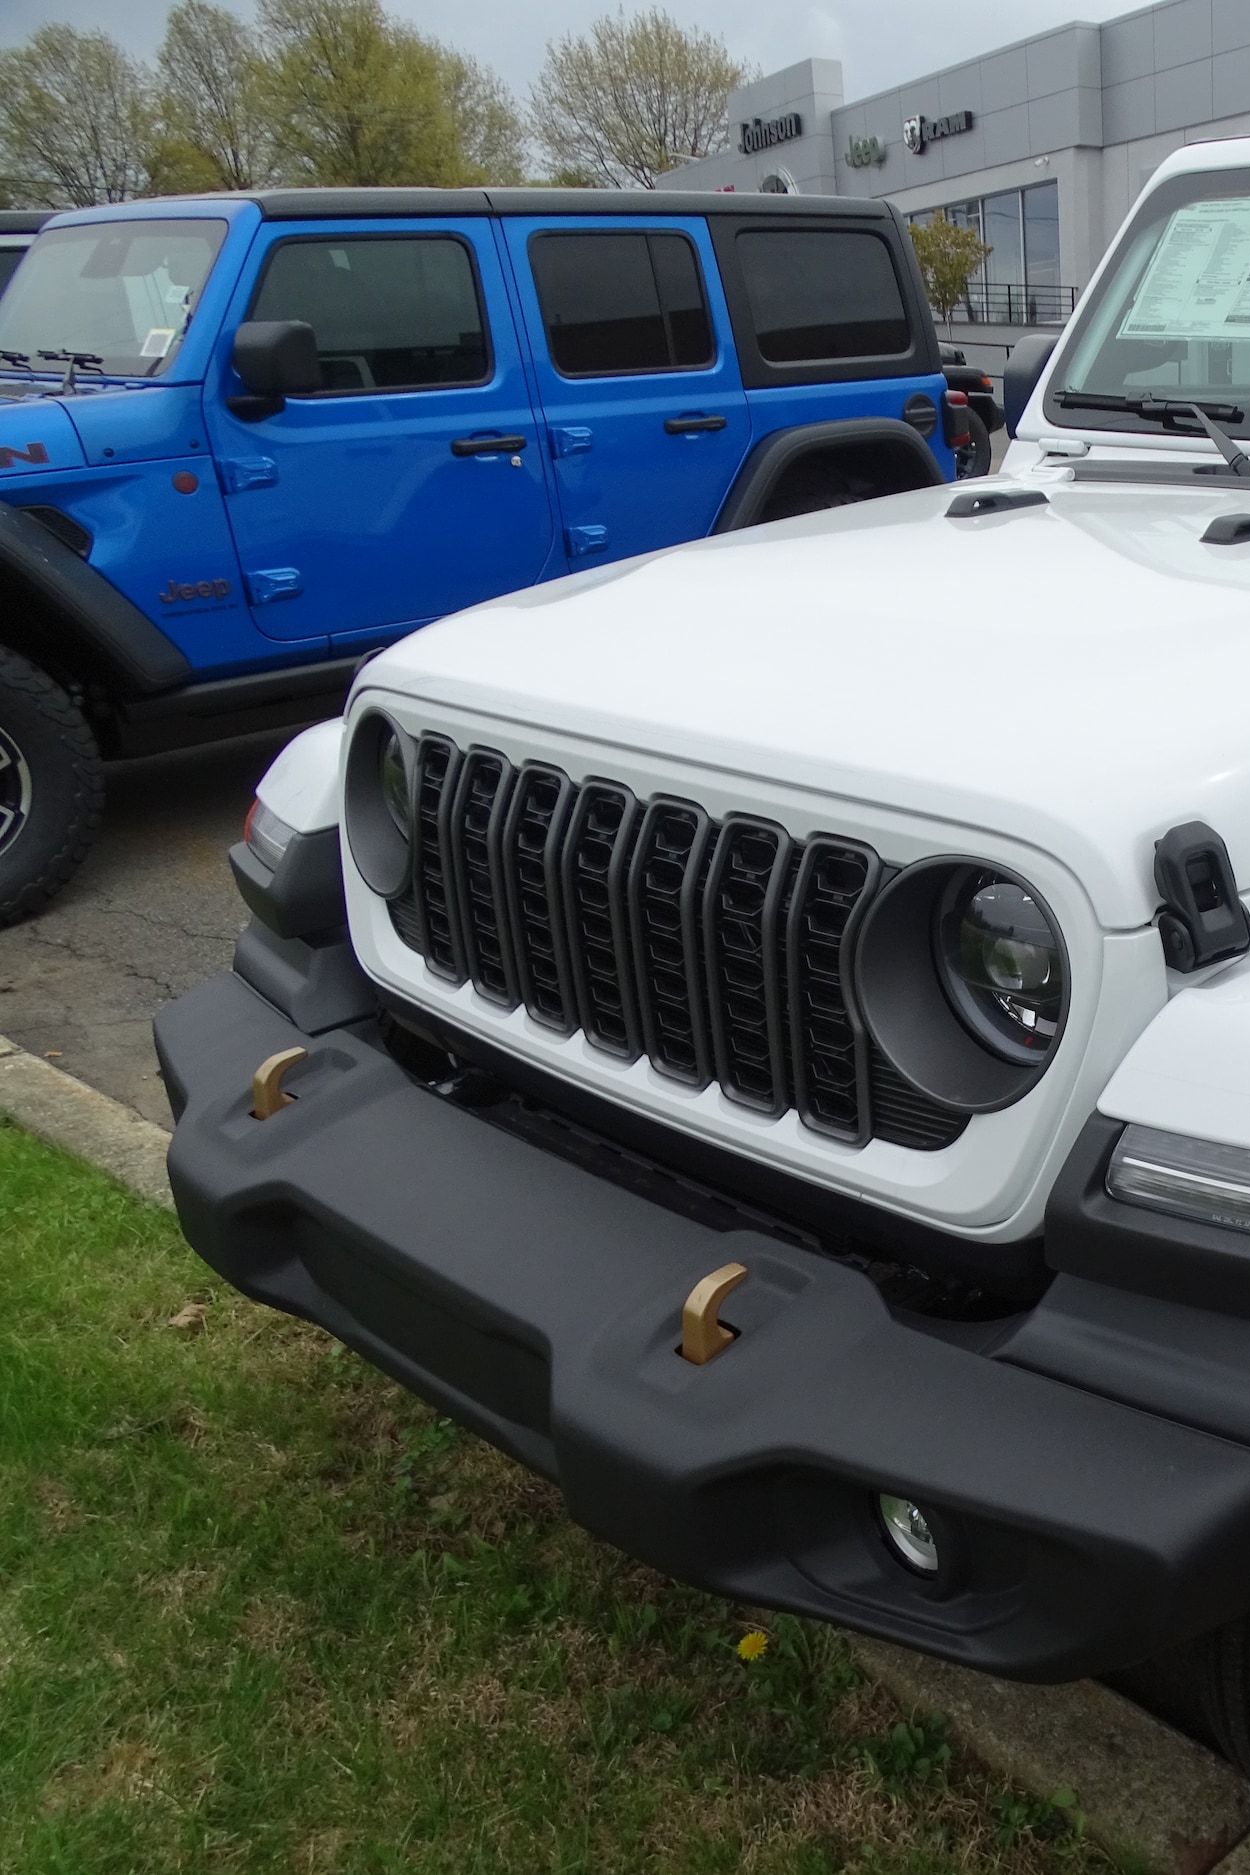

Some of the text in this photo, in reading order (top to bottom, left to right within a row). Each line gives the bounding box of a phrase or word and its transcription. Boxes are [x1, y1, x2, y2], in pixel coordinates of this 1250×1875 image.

[738, 112, 801, 155] Johnson
[922, 110, 973, 142] RAM
[844, 134, 886, 169] Jeep
[158, 577, 232, 604] Jeep
